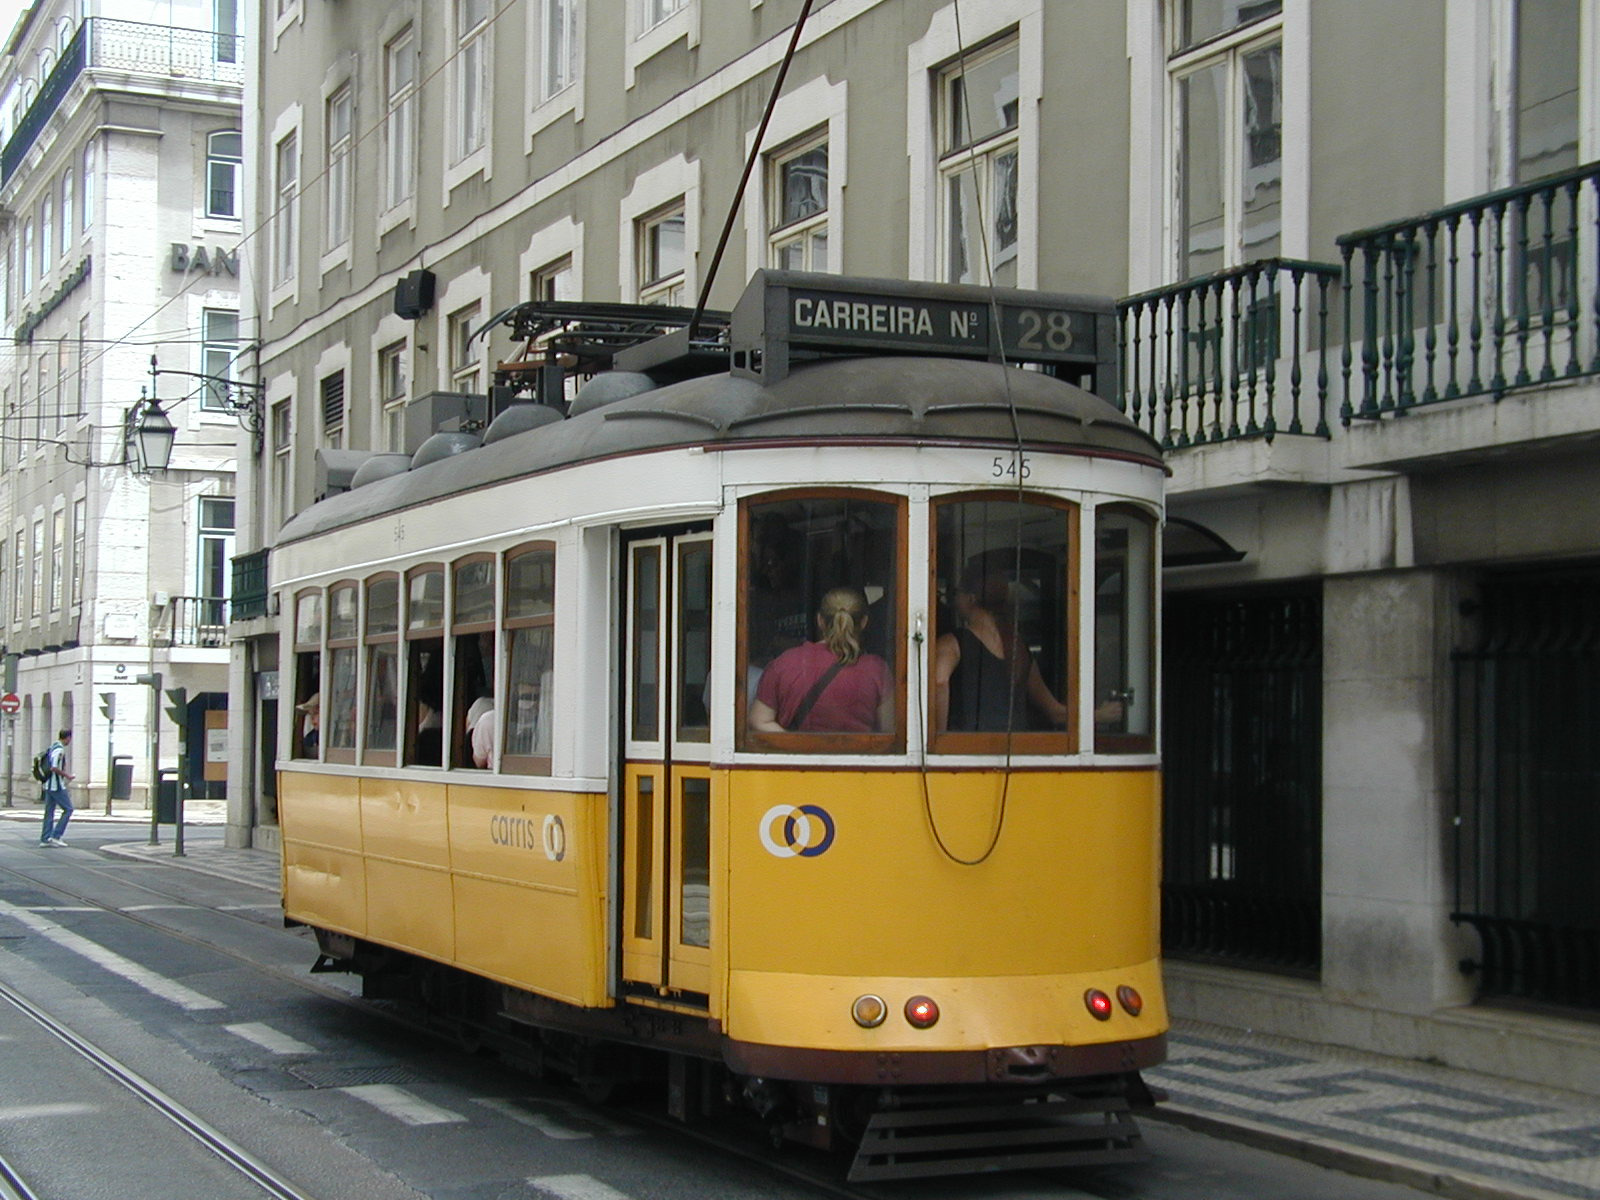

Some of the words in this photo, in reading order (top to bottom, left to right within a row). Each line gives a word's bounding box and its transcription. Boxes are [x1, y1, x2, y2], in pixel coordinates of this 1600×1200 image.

[794, 297, 934, 337] CARREIRA
[1017, 309, 1073, 352] 28
[490, 814, 535, 850] carris
